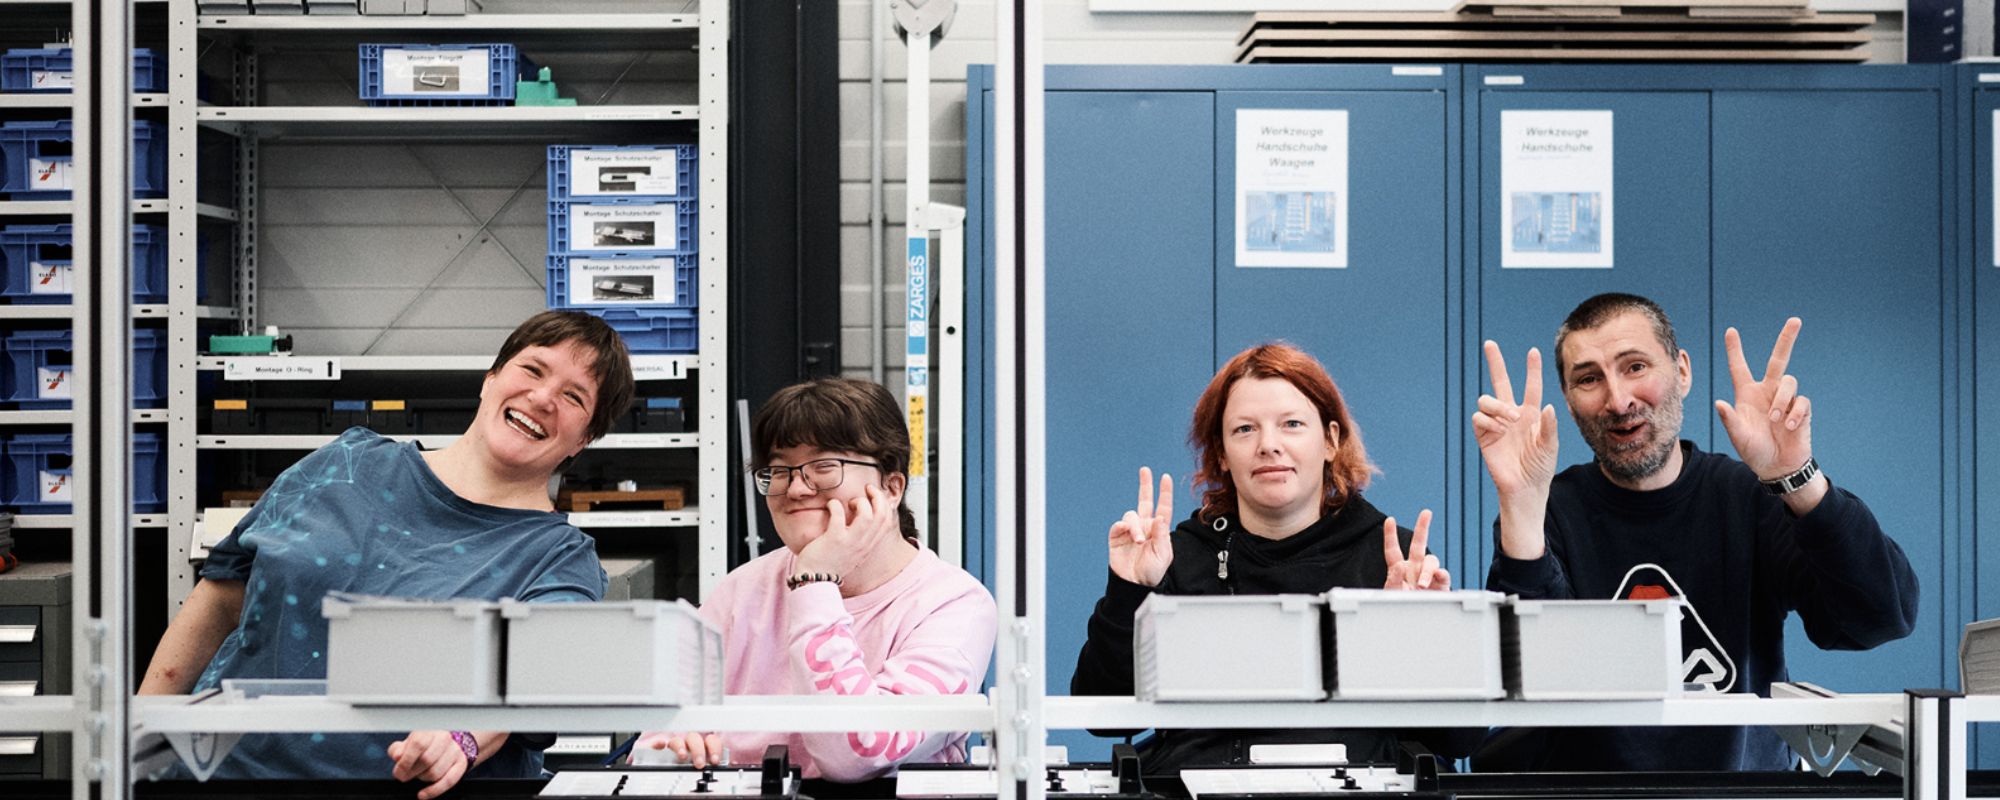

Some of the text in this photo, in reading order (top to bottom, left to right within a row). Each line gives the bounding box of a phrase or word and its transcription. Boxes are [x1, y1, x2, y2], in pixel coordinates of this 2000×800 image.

[1261, 126, 1324, 138] Werkzeuge
[1526, 127, 1589, 138] Werkzeuge
[1256, 142, 1328, 152] Handschuhe
[1521, 142, 1593, 152] Handschuhe
[1269, 158, 1315, 169] Waagen
[910, 255, 925, 319] ZARGES
[255, 366, 283, 374] Montage
[297, 366, 313, 374] Ring
